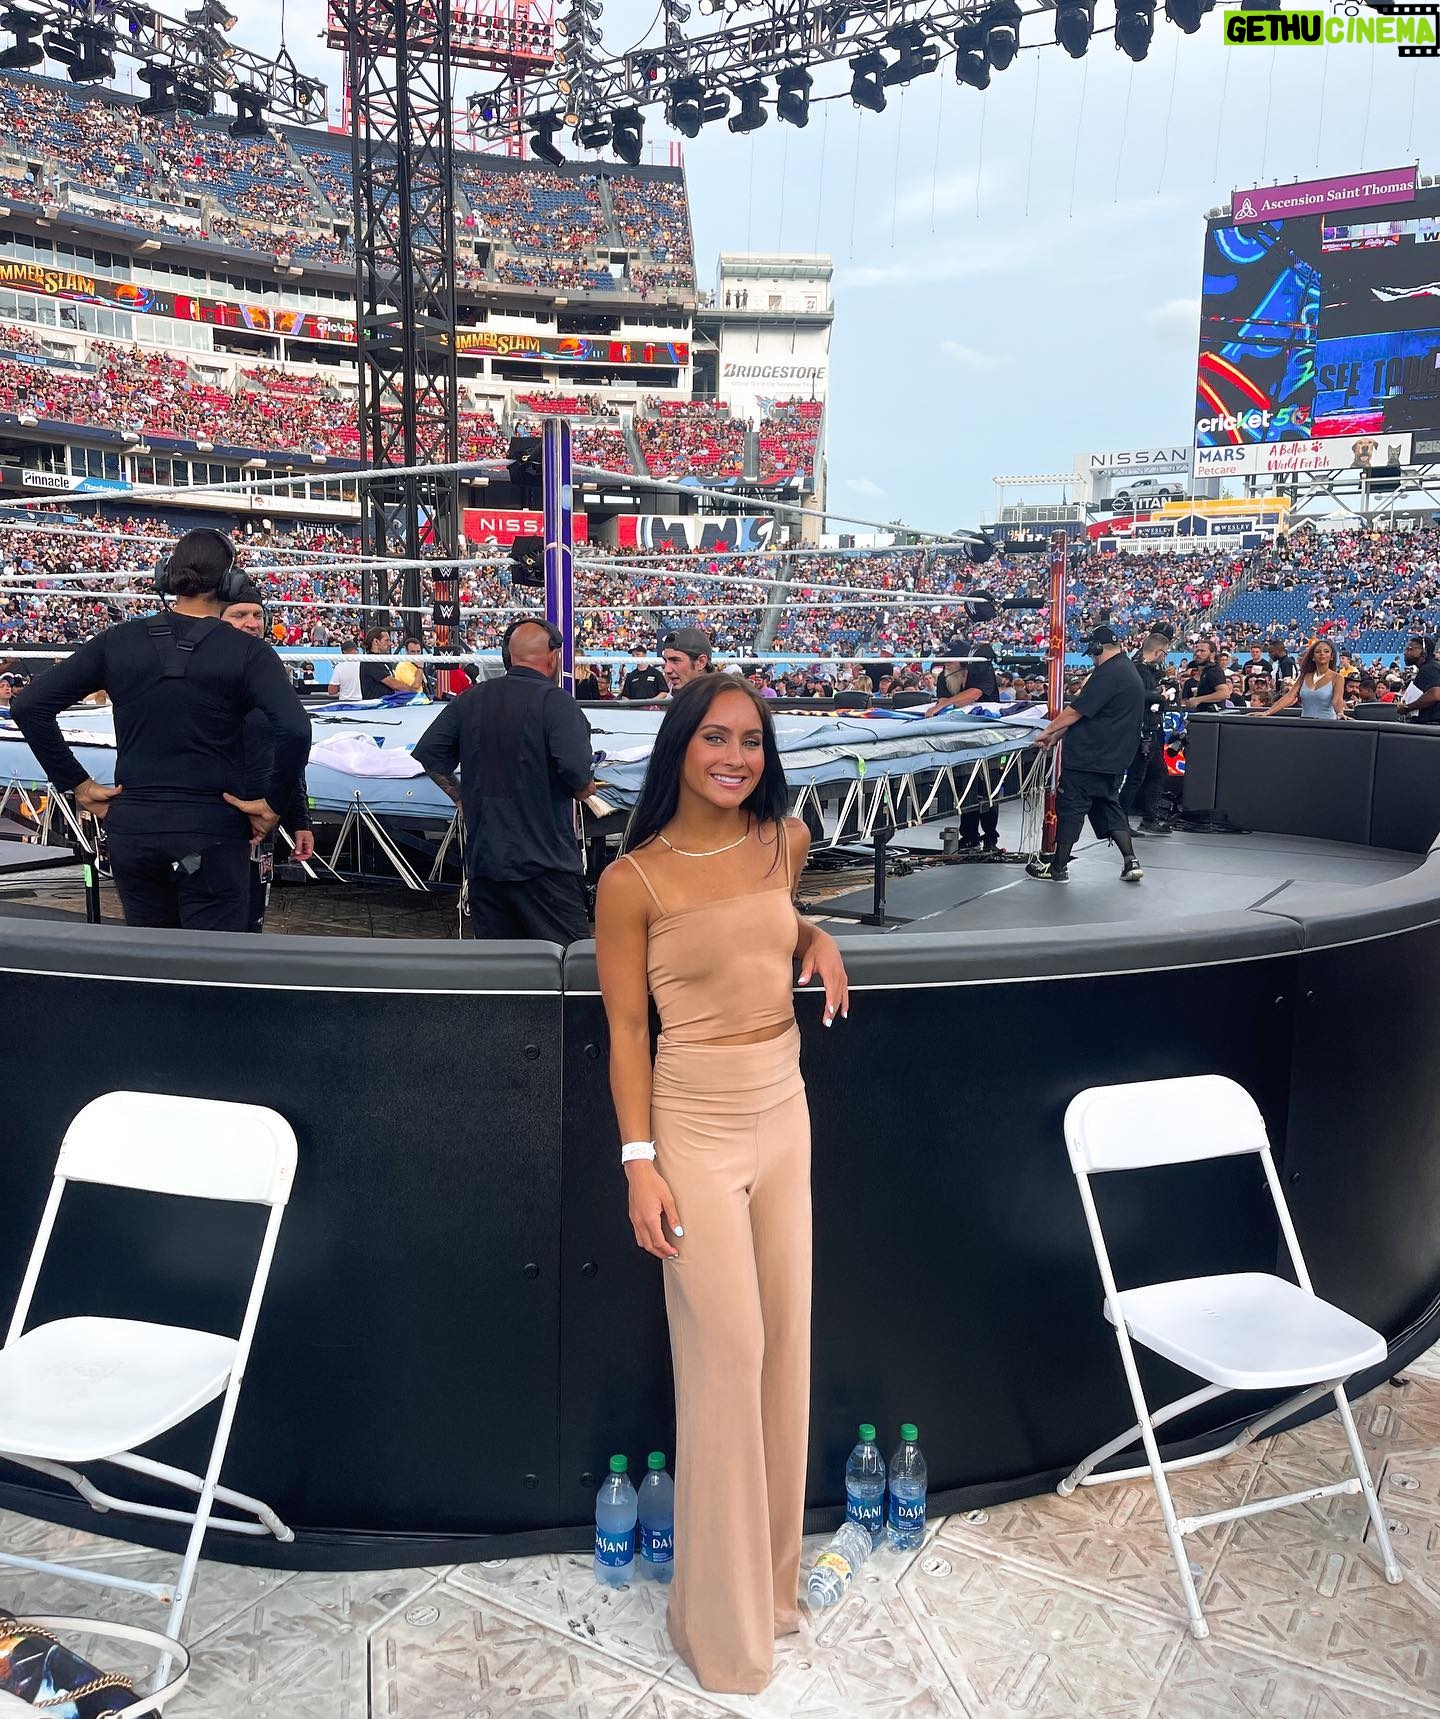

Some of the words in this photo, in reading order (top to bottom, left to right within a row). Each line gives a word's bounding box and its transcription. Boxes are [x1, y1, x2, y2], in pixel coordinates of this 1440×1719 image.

[1261, 194, 1324, 211] Ascension
[1326, 187, 1360, 201] Saint
[1362, 181, 1414, 197] Thomas
[317, 320, 355, 334] cricket
[723, 363, 826, 379] BRIDGESTONE
[1197, 409, 1270, 433] cricket
[1272, 406, 1311, 427] 5G
[1091, 448, 1187, 466] NISSAN
[1199, 447, 1246, 463] MARS
[1269, 444, 1277, 456] A
[1198, 466, 1237, 476] Petcare
[1267, 457, 1298, 471] World
[1314, 455, 1330, 469] Pets
[24, 471, 70, 489] Pinnacle
[1130, 496, 1172, 509] TITAN
[480, 517, 545, 533] NISS
[847, 1502, 881, 1520] DASANI
[898, 1503, 926, 1519] DASA
[652, 1534, 673, 1549] DAS
